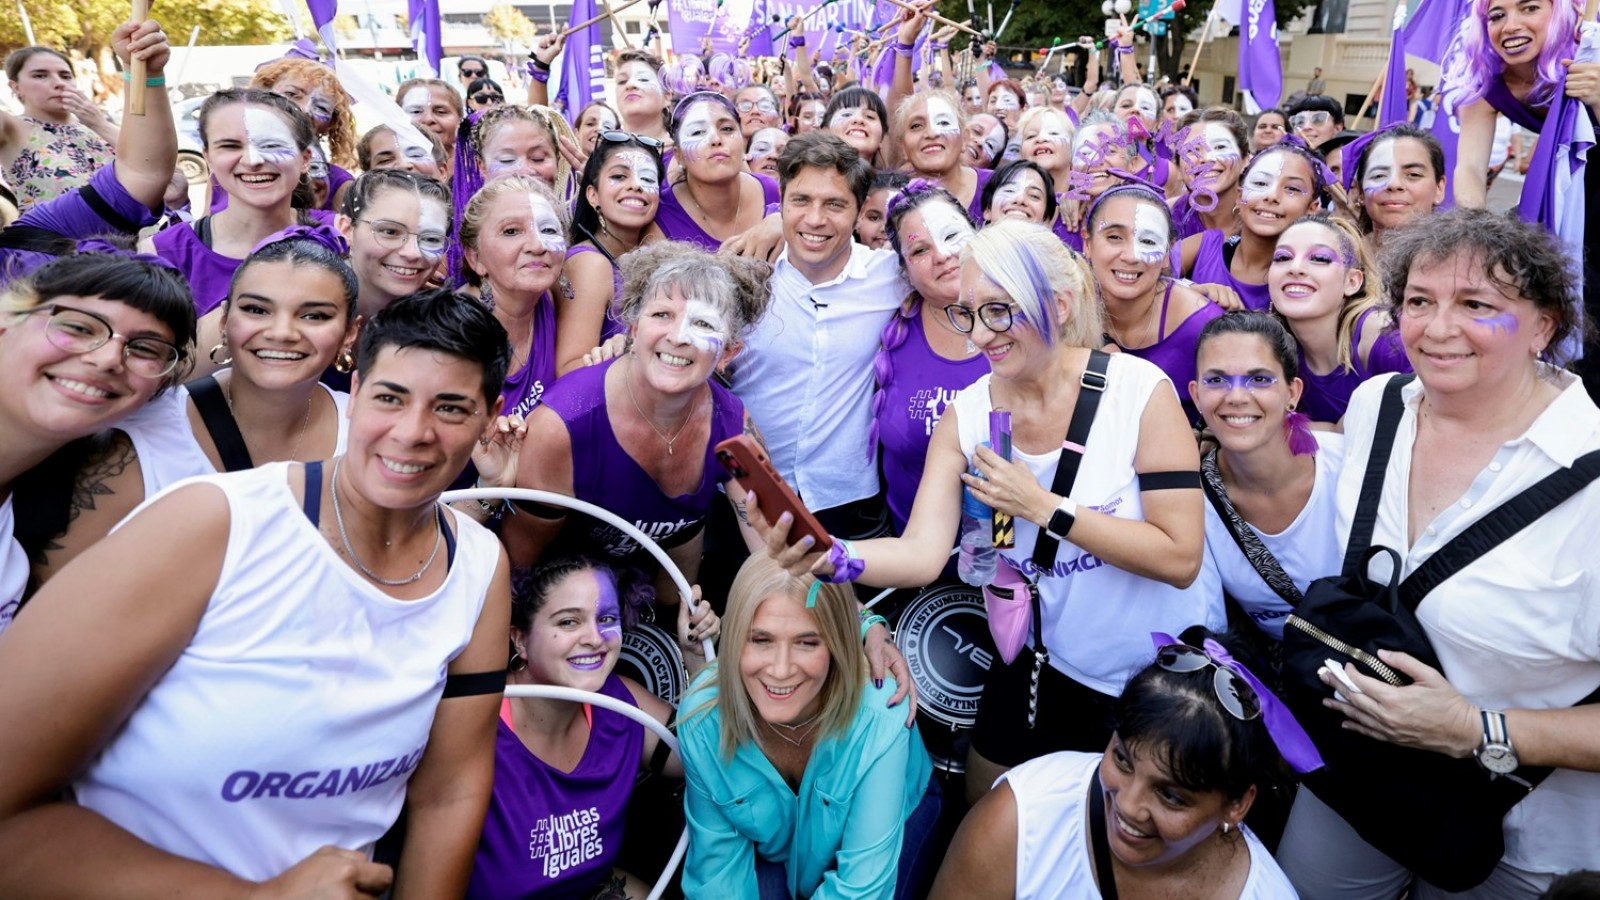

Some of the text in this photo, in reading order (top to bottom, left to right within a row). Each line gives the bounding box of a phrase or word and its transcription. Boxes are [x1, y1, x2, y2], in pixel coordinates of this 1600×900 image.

[755, 0, 793, 28] SAN
[1100, 496, 1123, 512] Somos
[910, 593, 985, 636] INSTRUMENTO
[651, 655, 672, 702] OCTAV
[916, 674, 978, 710] ARGENTIN
[221, 745, 426, 803] ORGANIZAC
[543, 837, 603, 878] Iguales
[550, 822, 598, 855] Libres
